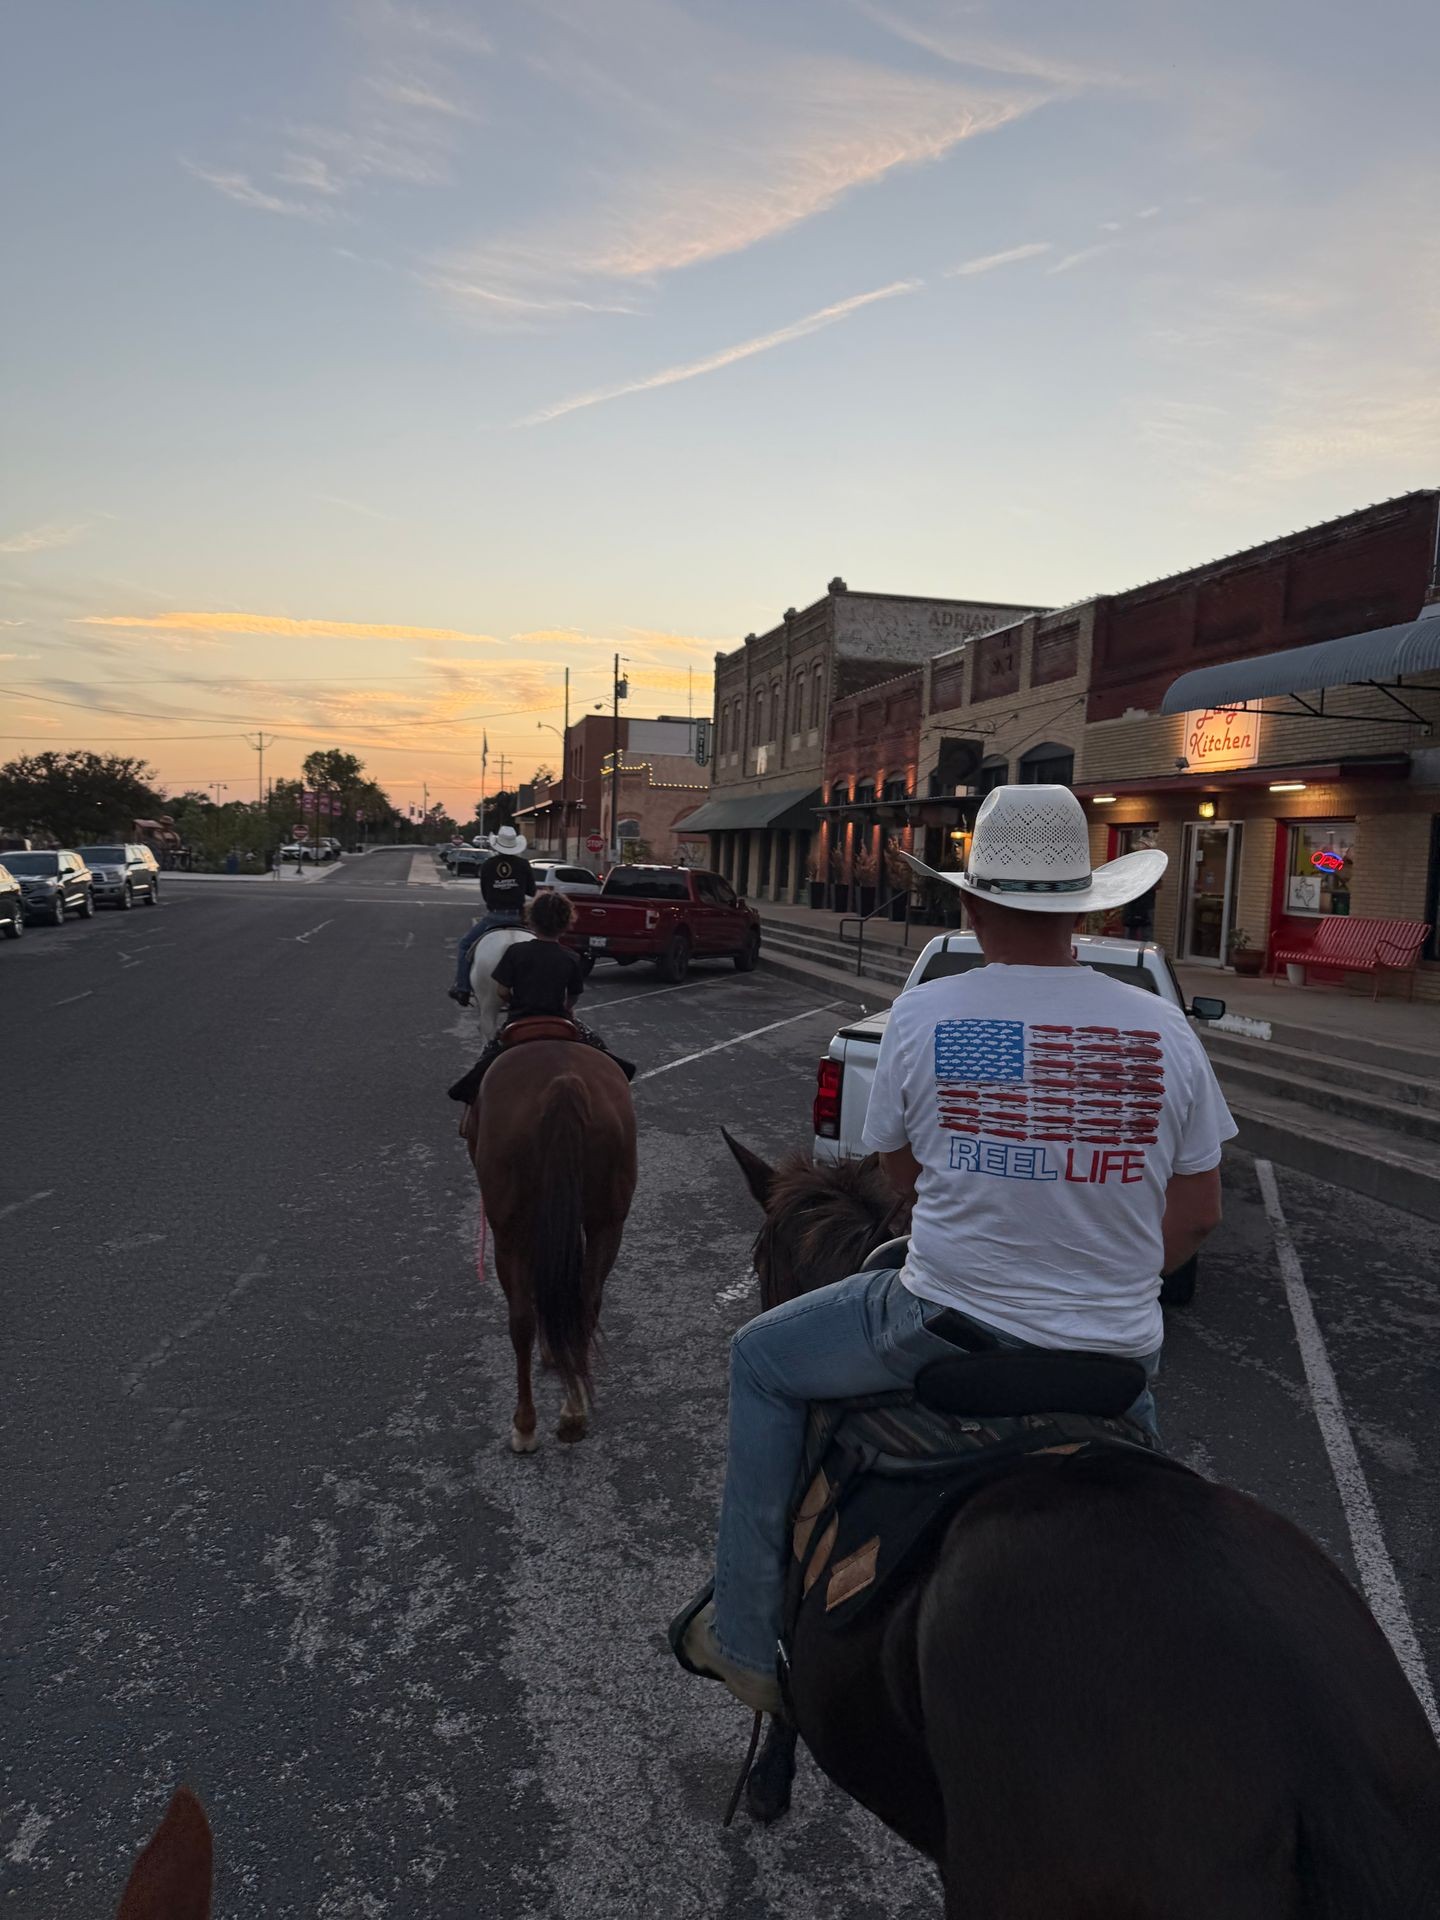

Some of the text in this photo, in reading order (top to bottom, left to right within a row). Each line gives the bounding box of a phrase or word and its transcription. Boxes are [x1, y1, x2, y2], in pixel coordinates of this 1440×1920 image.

[929, 610, 996, 630] ADRIAN
[1190, 728, 1251, 758] Kitchen
[587, 839, 605, 849] STOP
[950, 1136, 1145, 1184] REEL LIFE
